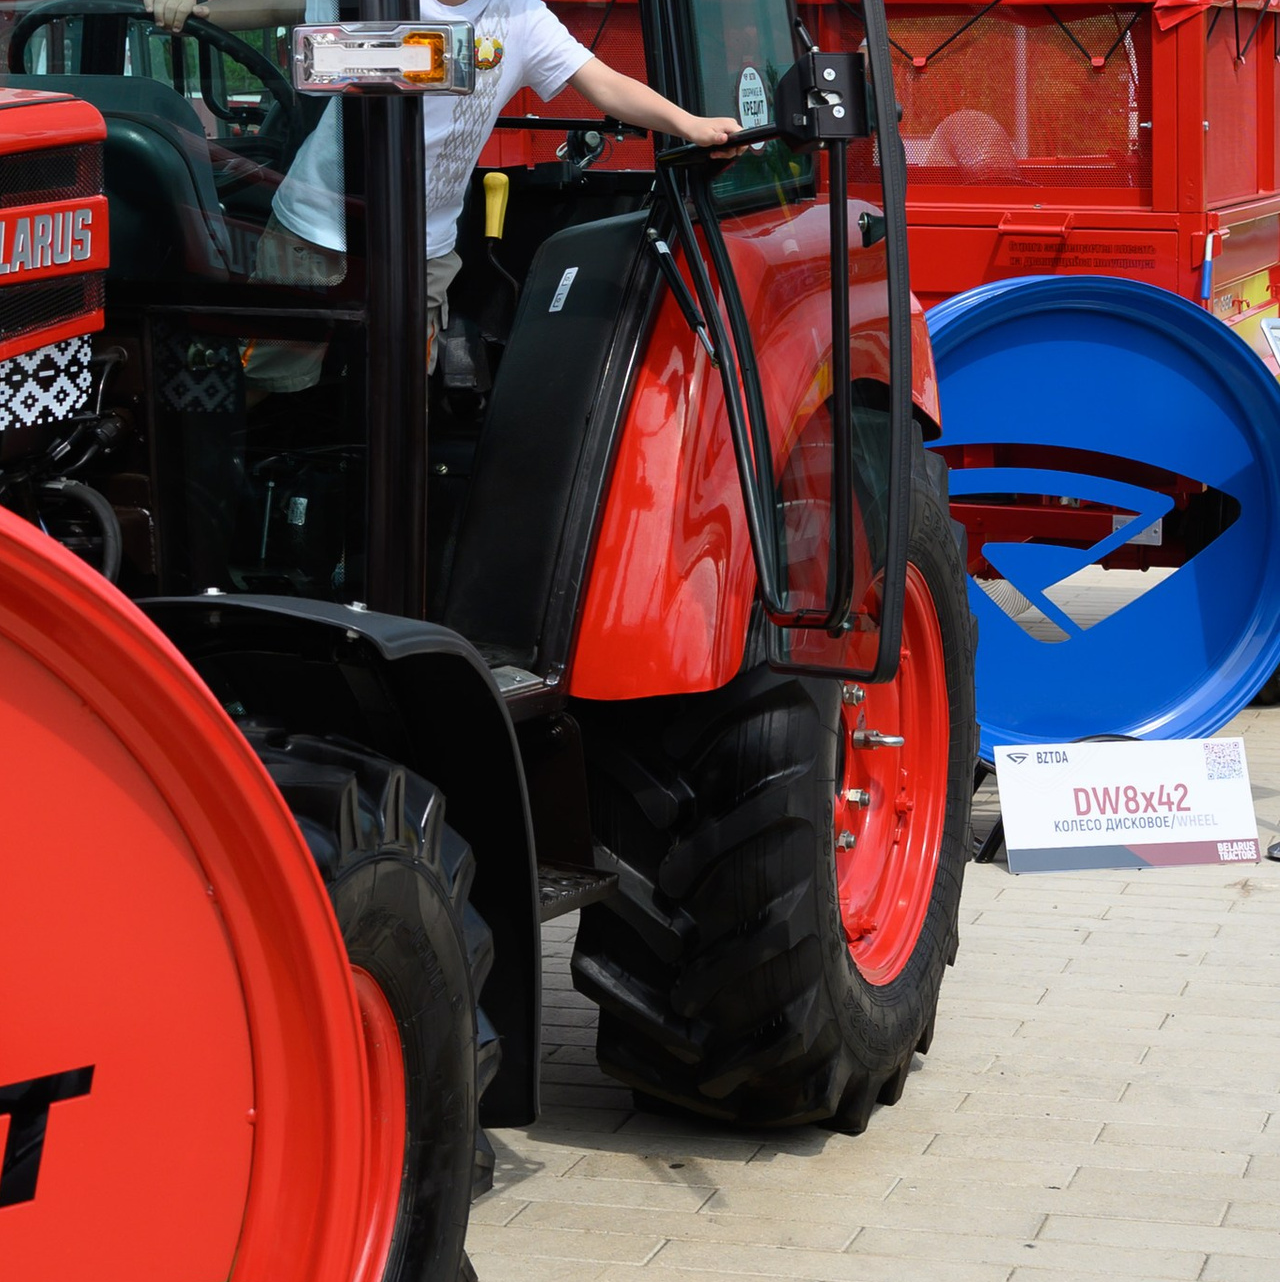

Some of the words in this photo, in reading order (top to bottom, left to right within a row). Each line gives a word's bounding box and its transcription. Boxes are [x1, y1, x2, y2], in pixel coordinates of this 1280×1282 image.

[1036, 751, 1069, 764] BZTDA
[1073, 783, 1191, 816] DW8x42
[1054, 818, 1102, 833] КОЛЕСО
[1105, 813, 1219, 832] ДИСКОВОЕ/WHEEL
[1217, 841, 1255, 852] BELARUS
[1218, 849, 1257, 861] TRACTORS
